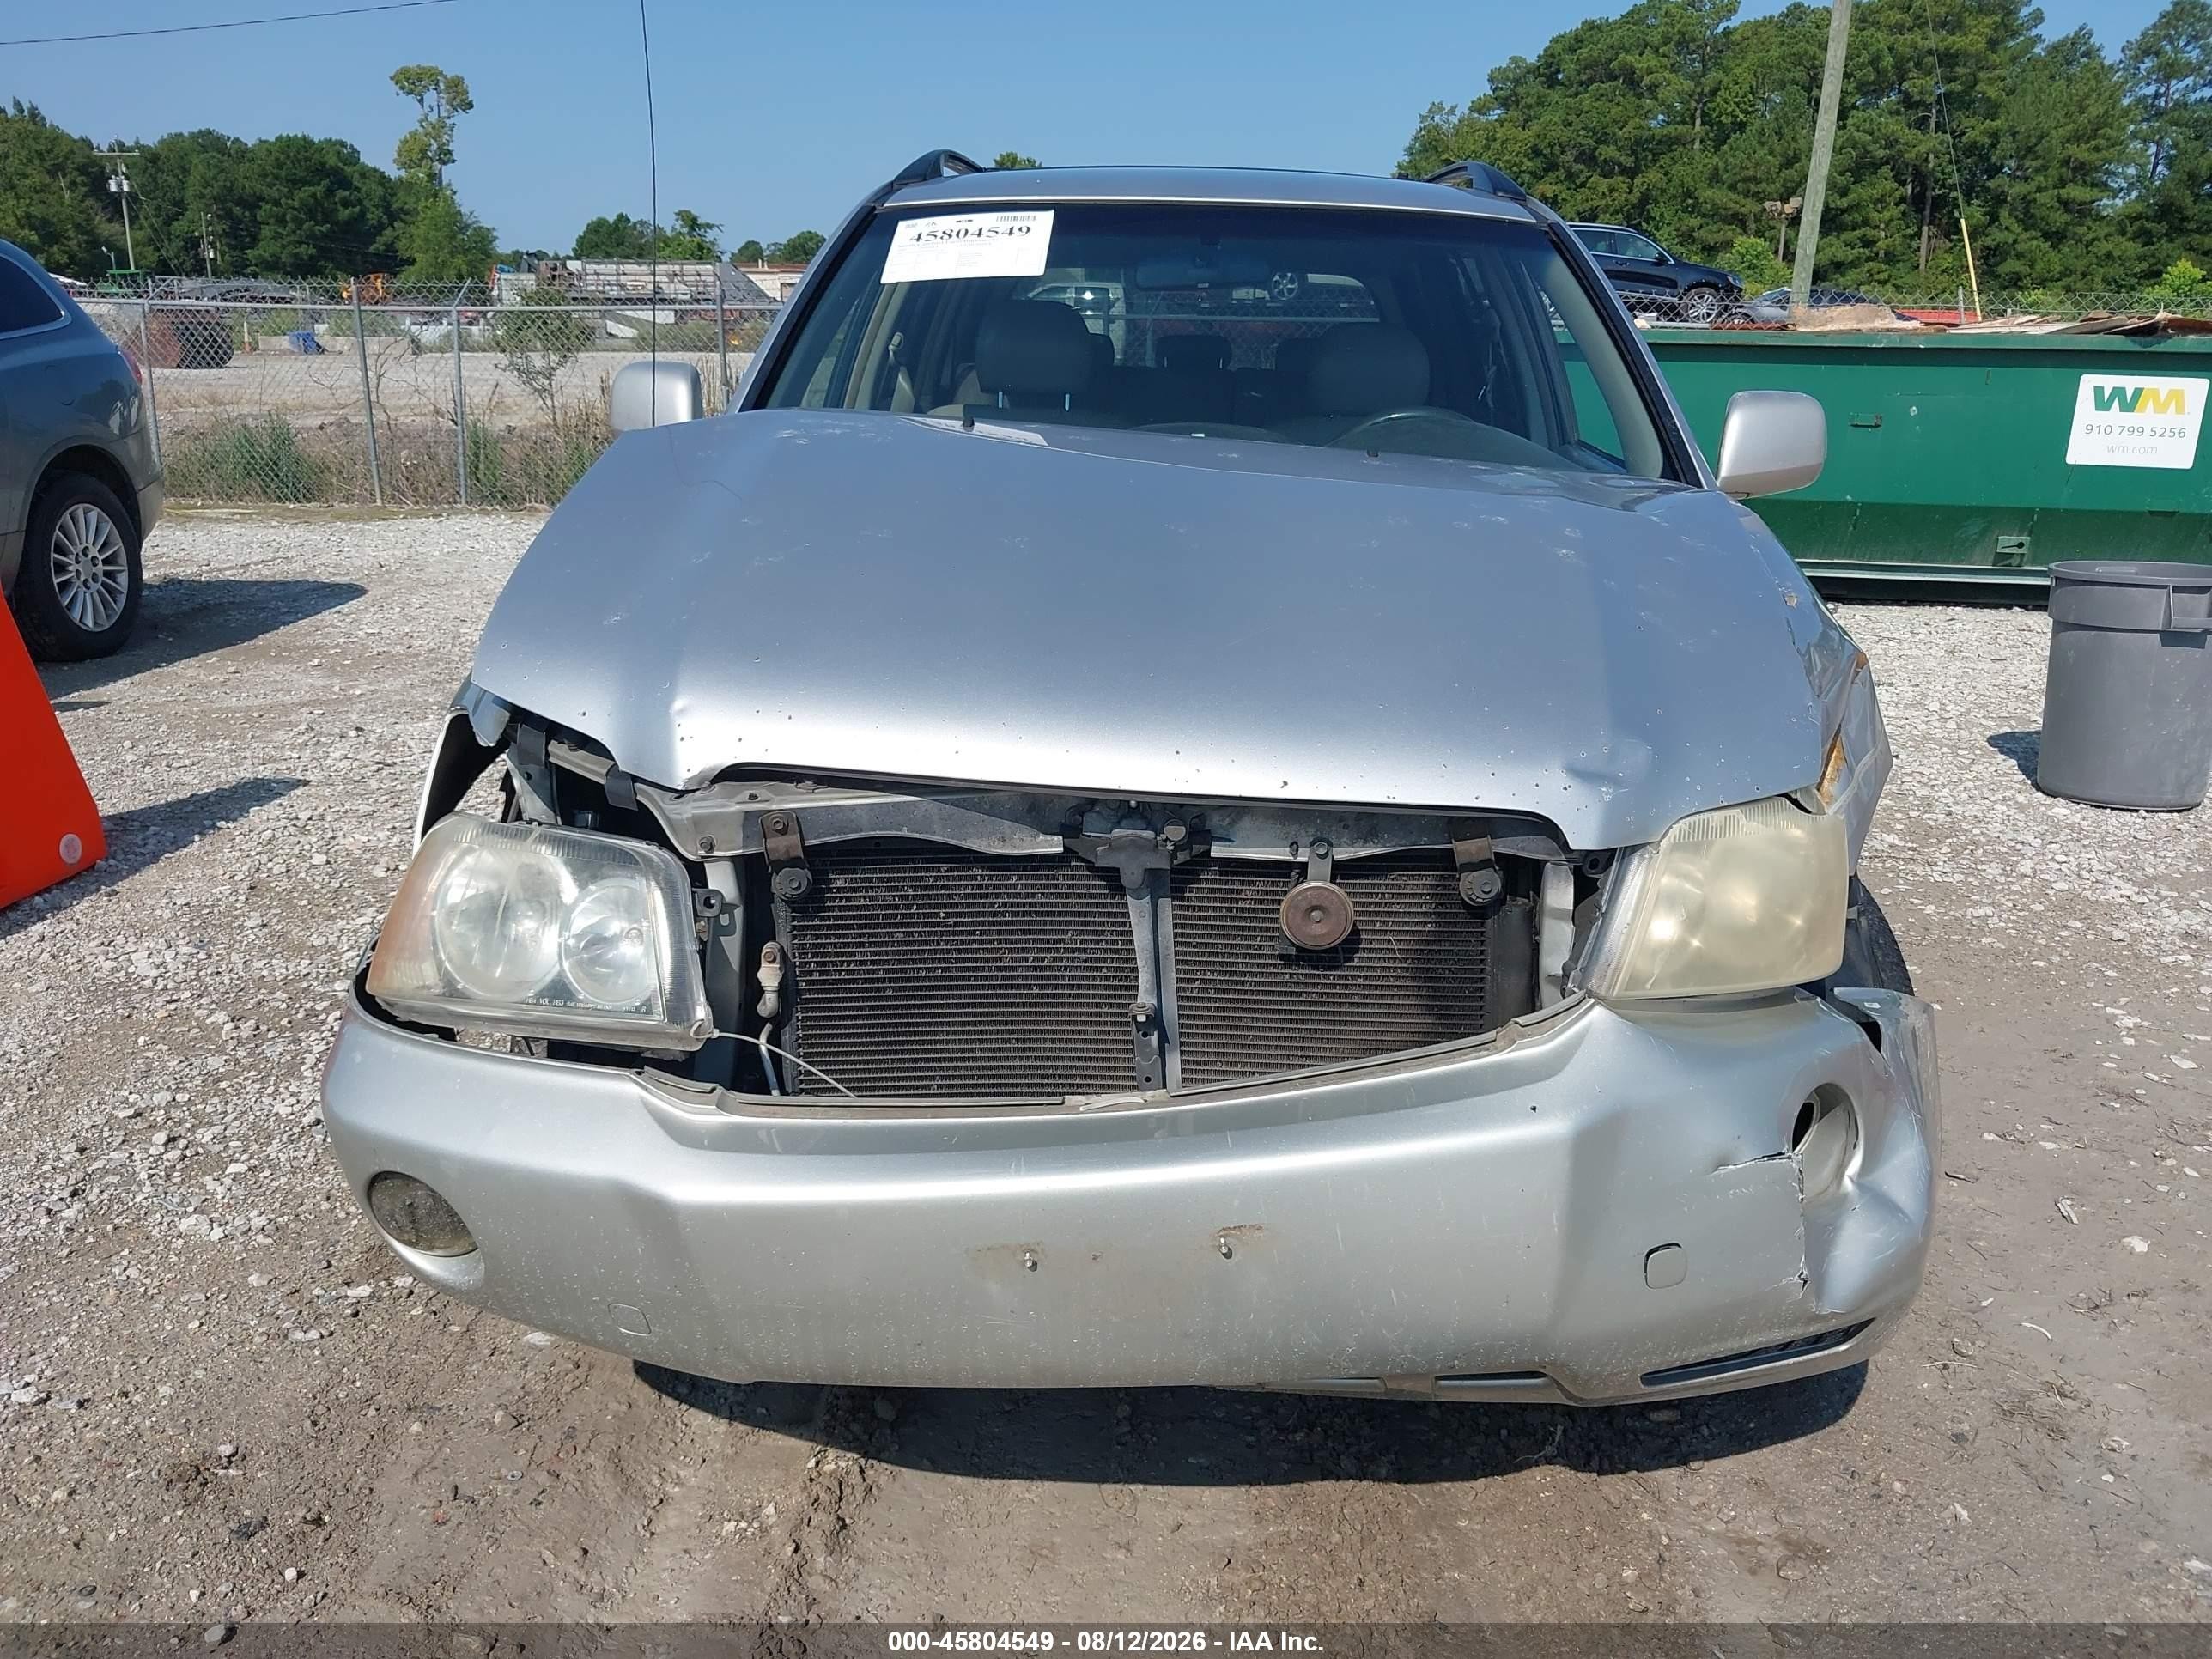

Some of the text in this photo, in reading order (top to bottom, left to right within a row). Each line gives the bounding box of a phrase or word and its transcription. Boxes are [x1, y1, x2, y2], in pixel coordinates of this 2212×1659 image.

[908, 224, 1031, 242] 45804549
[2093, 386, 2186, 415] WM
[2085, 423, 2187, 439] 910 799 5256
[2106, 445, 2158, 455] wm.com
